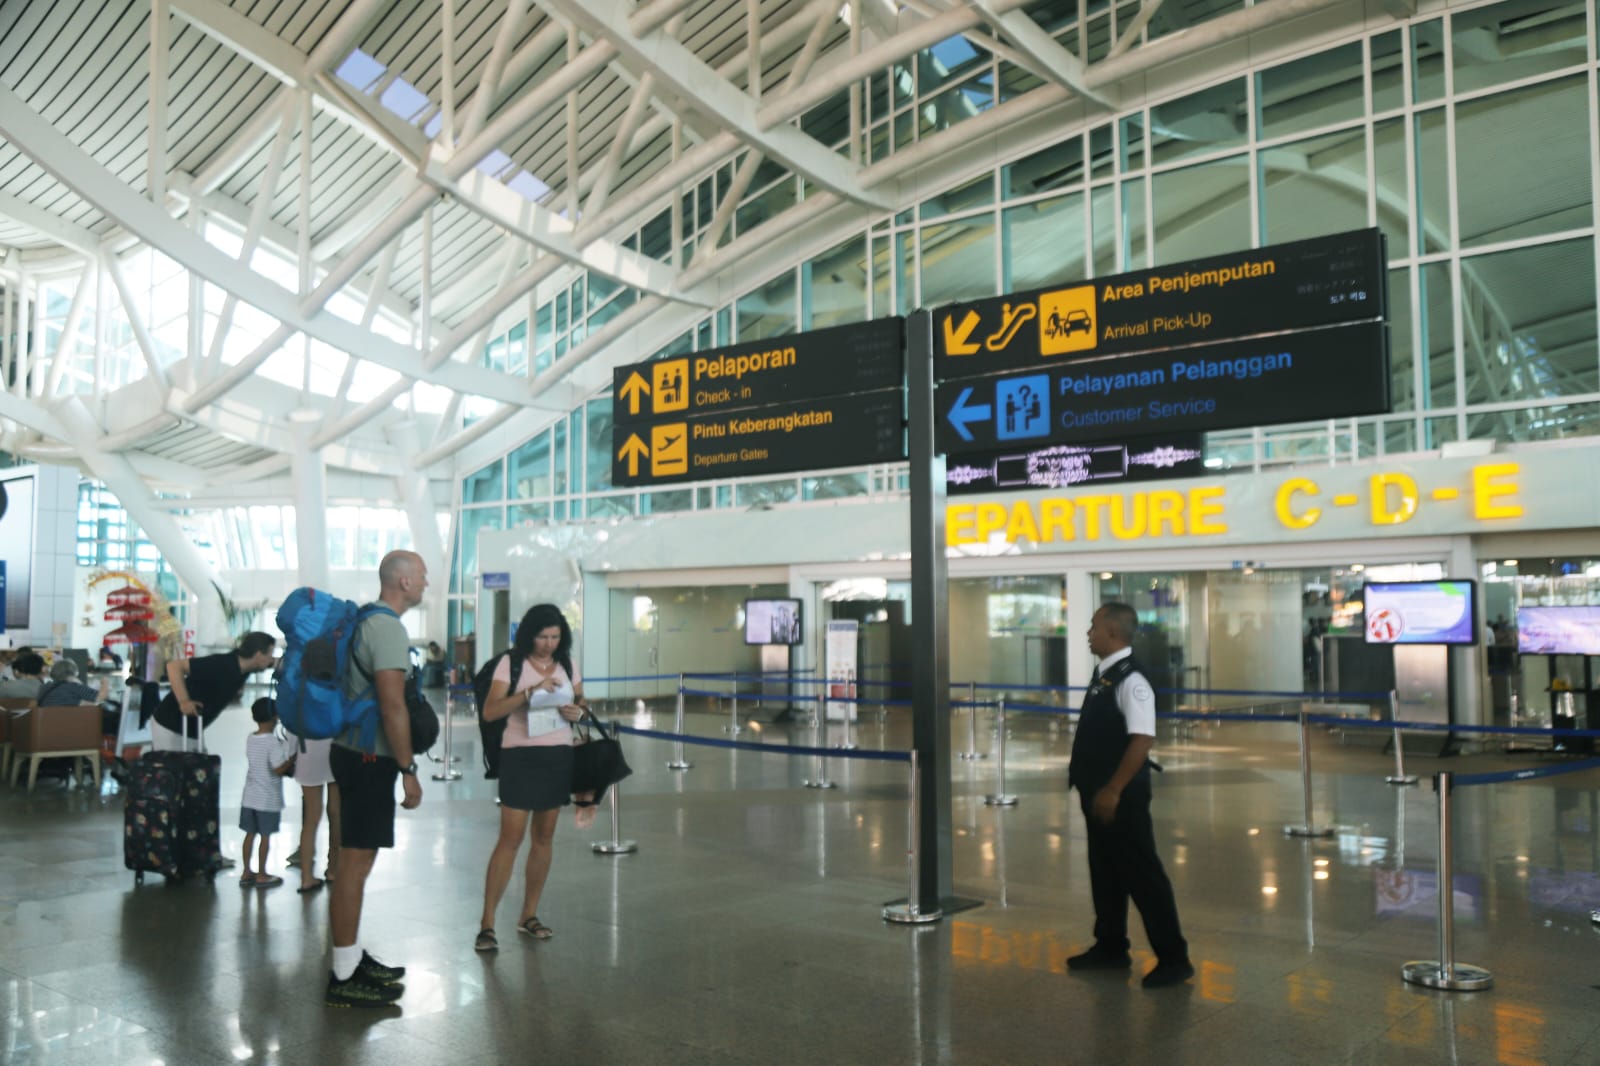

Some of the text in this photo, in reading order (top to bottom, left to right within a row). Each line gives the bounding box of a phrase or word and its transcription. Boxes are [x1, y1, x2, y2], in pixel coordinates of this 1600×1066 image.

[1102, 282, 1145, 303] Area
[1147, 259, 1277, 297] Penjemputan
[1103, 313, 1213, 341] Arrival Pick-Up
[694, 346, 797, 381] Pelaporan
[1058, 351, 1293, 396] Pelayanan Pelanggan
[695, 388, 731, 406] Check
[1060, 397, 1217, 429] Customer Service
[693, 410, 833, 439] Pintu Keberangkatan
[694, 448, 769, 467] Departure Gates
[945, 486, 1228, 547] EPARTURE
